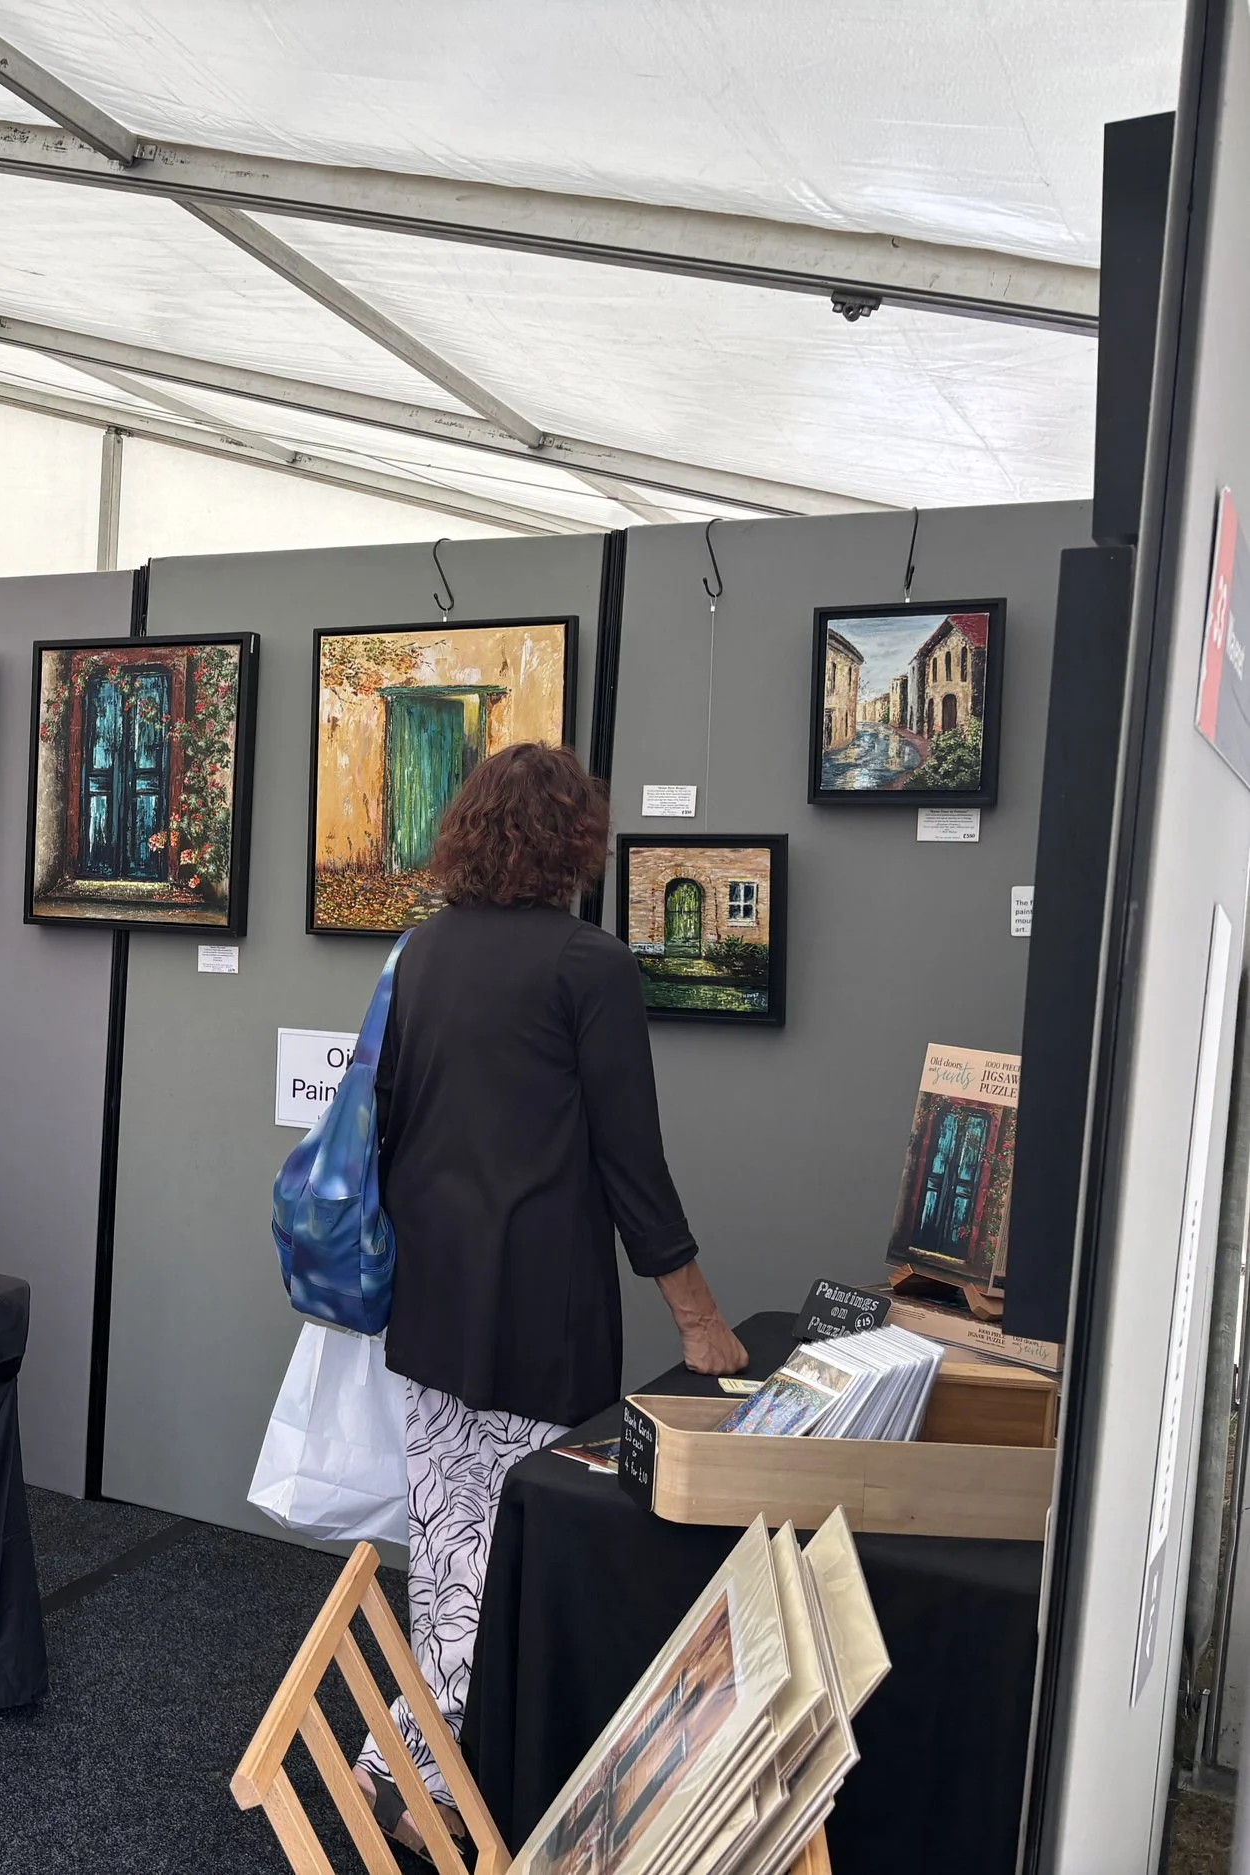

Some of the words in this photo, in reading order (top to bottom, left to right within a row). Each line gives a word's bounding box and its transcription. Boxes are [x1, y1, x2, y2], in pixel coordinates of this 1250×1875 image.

[327, 1047, 355, 1068] Oi
[930, 1057, 943, 1066] Old
[943, 1059, 963, 1069] doors
[985, 1060, 1001, 1069] 1000
[981, 1070, 1018, 1084] JIGSAW
[292, 1078, 340, 1101] Pain
[980, 1083, 1018, 1098] PUZZLE
[816, 1281, 880, 1312] Paintings
[831, 1306, 848, 1319] on
[857, 1316, 871, 1327] £15
[986, 1335, 1005, 1344] PUZZLE
[624, 1406, 637, 1430] Blank
[638, 1418, 652, 1443] Cards
[625, 1428, 632, 1442] £3
[632, 1438, 643, 1452] each
